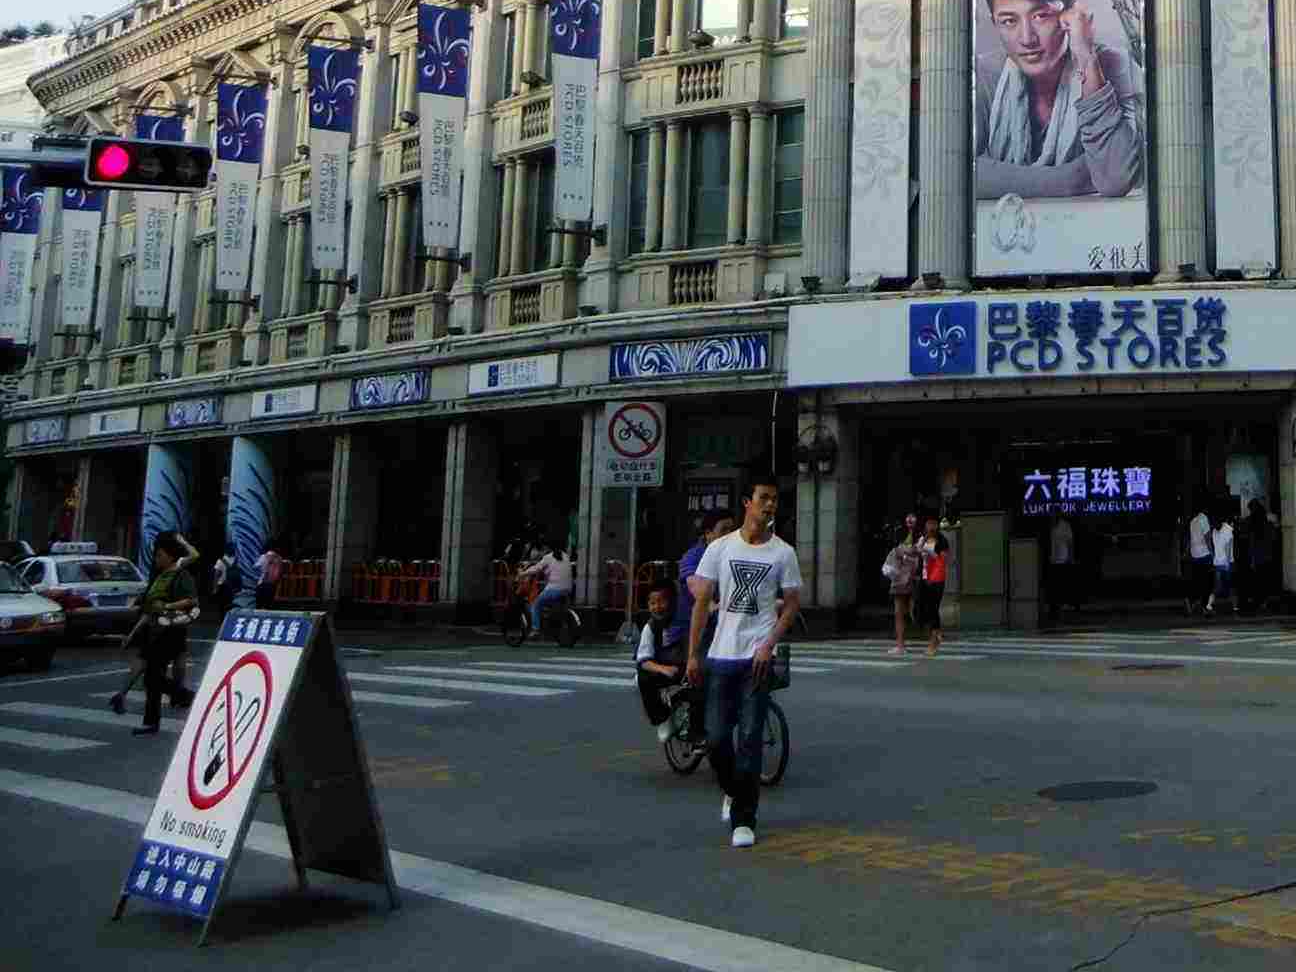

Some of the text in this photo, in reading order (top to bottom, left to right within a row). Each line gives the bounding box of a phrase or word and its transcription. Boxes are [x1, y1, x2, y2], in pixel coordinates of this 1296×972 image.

[987, 298, 1227, 341] 巴黎春天百货
[986, 331, 1227, 374] PCD STORES
[1023, 466, 1152, 500] 六福珠寶
[159, 810, 228, 849] No smoking
